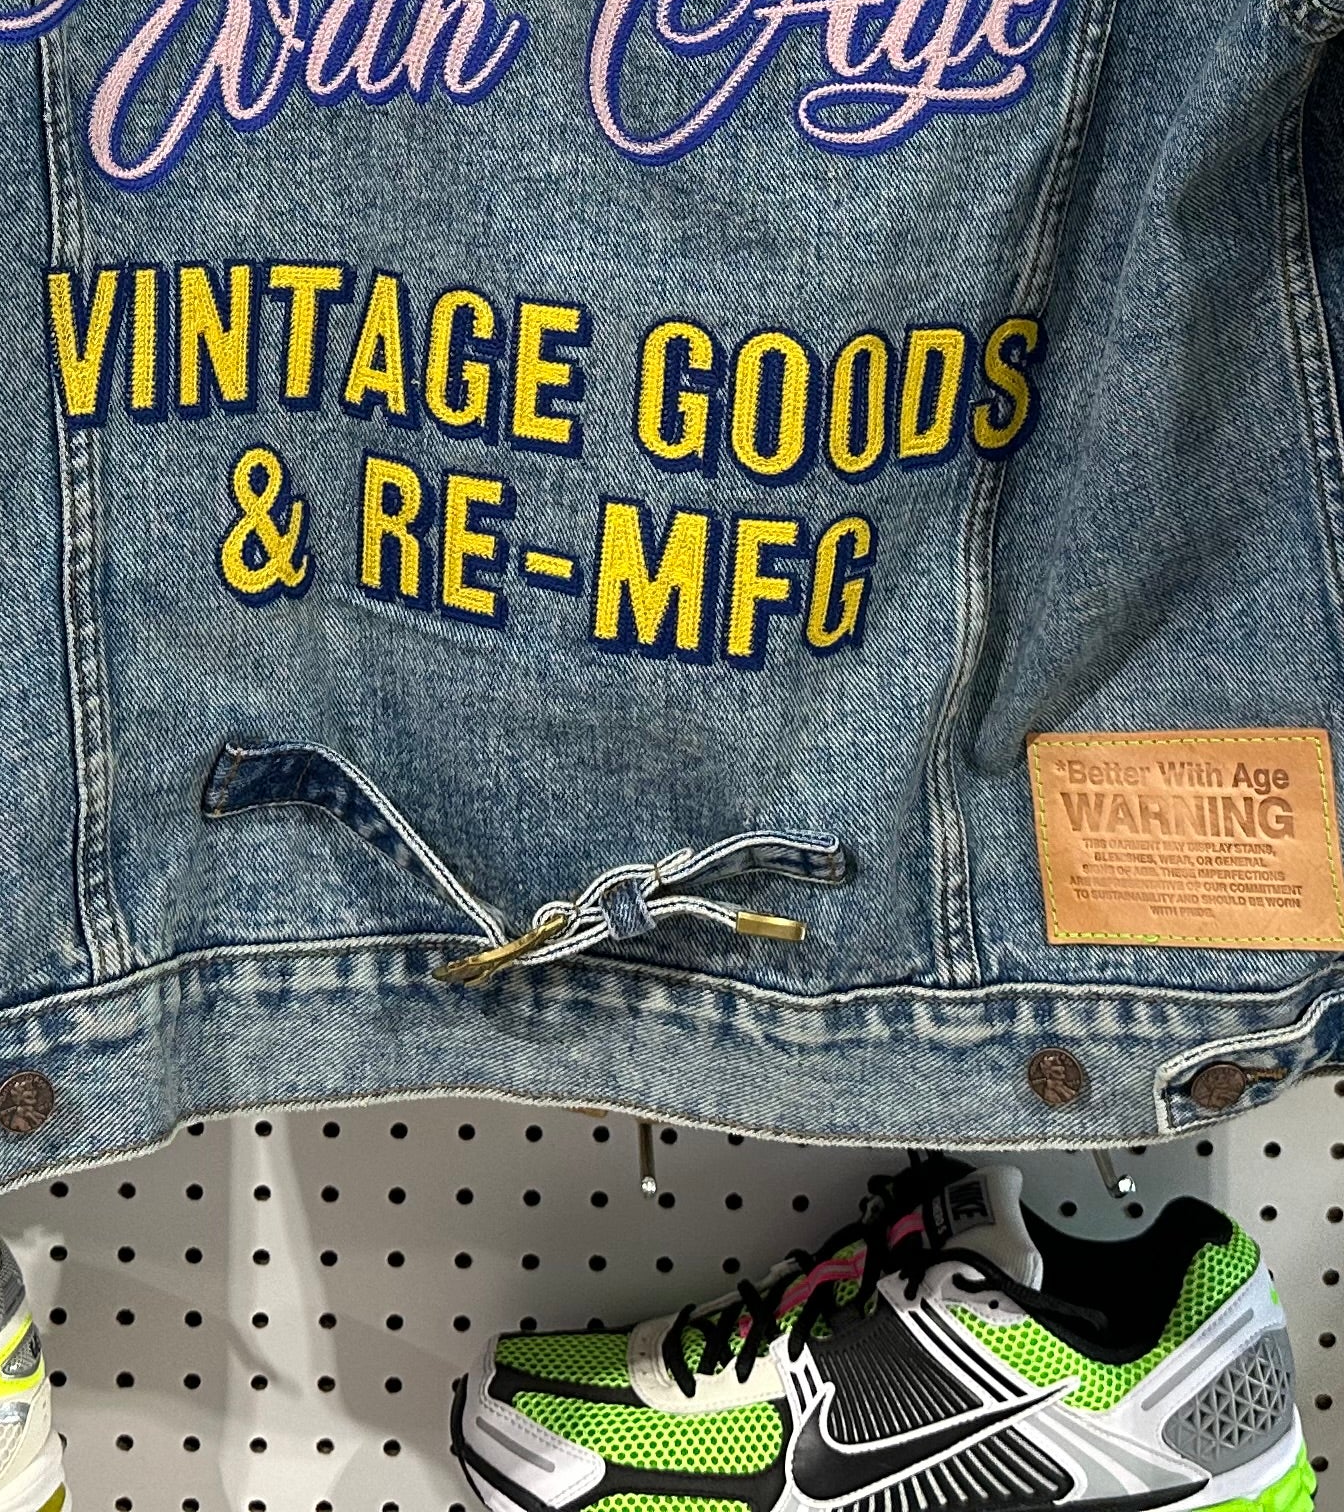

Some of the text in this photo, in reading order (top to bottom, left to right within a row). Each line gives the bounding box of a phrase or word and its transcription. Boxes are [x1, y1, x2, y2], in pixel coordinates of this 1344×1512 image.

[43, 260, 1046, 487] VINTAGE GOODS
[215, 443, 878, 669] & RE-MFG
[1159, 760, 1224, 788] With
[1231, 761, 1291, 796] Age
[1059, 791, 1297, 840] WARNING
[1108, 839, 1160, 851] GARMENT
[1186, 842, 1232, 854] DISPLAY
[1233, 843, 1277, 857] STAINS,
[1158, 854, 1195, 867] WEAR,
[1196, 855, 1213, 866] OR
[1214, 856, 1268, 868] GENERAL
[1116, 865, 1131, 876] OF
[1160, 867, 1197, 880] THESE
[1197, 868, 1286, 882] IMPERFECTIONS
[1073, 888, 1302, 909] TO SUSTAINABILITY AND SHOULD BE WORN
[1185, 881, 1201, 892] OF
[1203, 882, 1227, 893] OUR
[1229, 883, 1303, 896] COMMITMENT
[1149, 905, 1179, 916] WITH
[946, 1180, 990, 1221] NIKE
